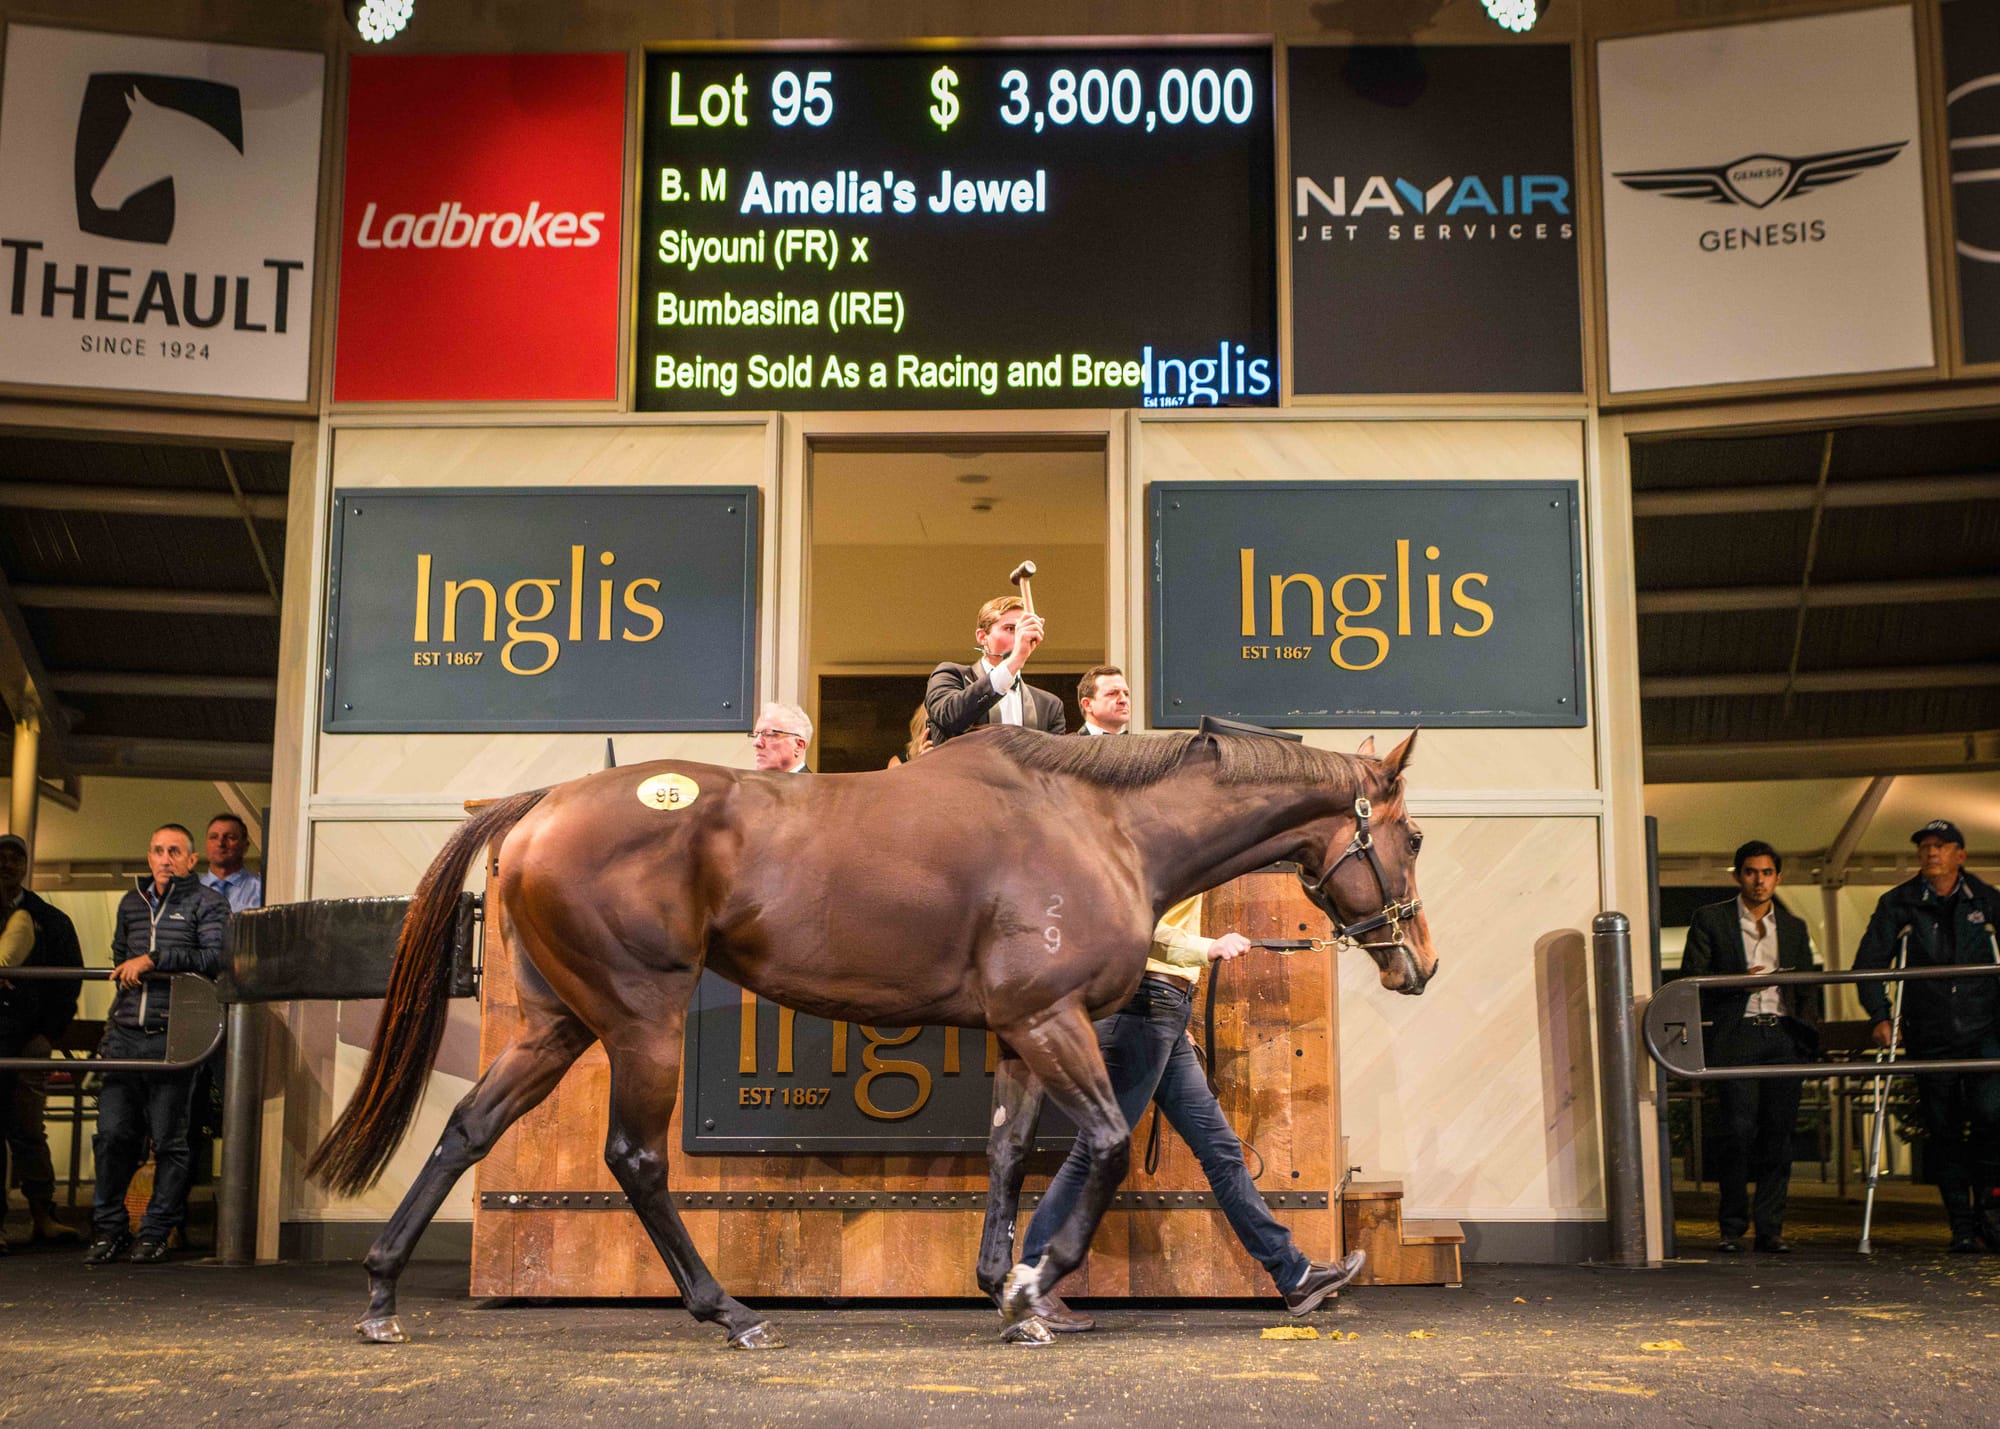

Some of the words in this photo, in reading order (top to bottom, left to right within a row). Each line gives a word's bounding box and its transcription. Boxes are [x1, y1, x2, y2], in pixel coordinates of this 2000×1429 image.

[670, 71, 749, 127] Lot
[771, 70, 834, 127] 95
[929, 65, 960, 132] $
[1000, 68, 1254, 133] 3,800,000
[660, 167, 690, 202] B.
[700, 167, 727, 202] M
[740, 169, 917, 214] Amelia's
[928, 169, 1047, 214] Jewel
[1733, 166, 1785, 182] GENESIS
[1296, 175, 1569, 217] NAVAIR
[357, 201, 606, 249] Ladbrokes
[1297, 224, 1359, 242] JET
[1388, 223, 1573, 242] SERVICES
[1699, 219, 1827, 253] GENESIS
[658, 228, 765, 272] Siyouni
[773, 229, 839, 271] (FR)
[850, 236, 869, 263] x
[1, 238, 304, 334] THEAULT
[656, 291, 820, 326] Bumbasina
[828, 291, 906, 334] (IRE)
[80, 335, 147, 357] SINCE
[159, 341, 211, 361] 1924
[654, 354, 738, 397] Being
[747, 354, 813, 389] Sold
[820, 354, 861, 389] As
[868, 361, 888, 389] a
[897, 354, 999, 396] Racing
[1006, 354, 1062, 388] and
[1071, 353, 1145, 388] Bree
[1143, 341, 1272, 405] Inglis
[414, 545, 665, 676] Inglis
[1240, 538, 1495, 671] Inglis
[413, 651, 441, 666] EST
[445, 651, 484, 666] 1867
[1241, 645, 1270, 660] EST
[1273, 645, 1313, 660] 1867
[656, 787, 680, 803] 95
[1046, 894, 1065, 919] 2
[1043, 926, 1061, 954] 9
[738, 1087, 775, 1105] EST
[779, 1087, 831, 1106] 1867
